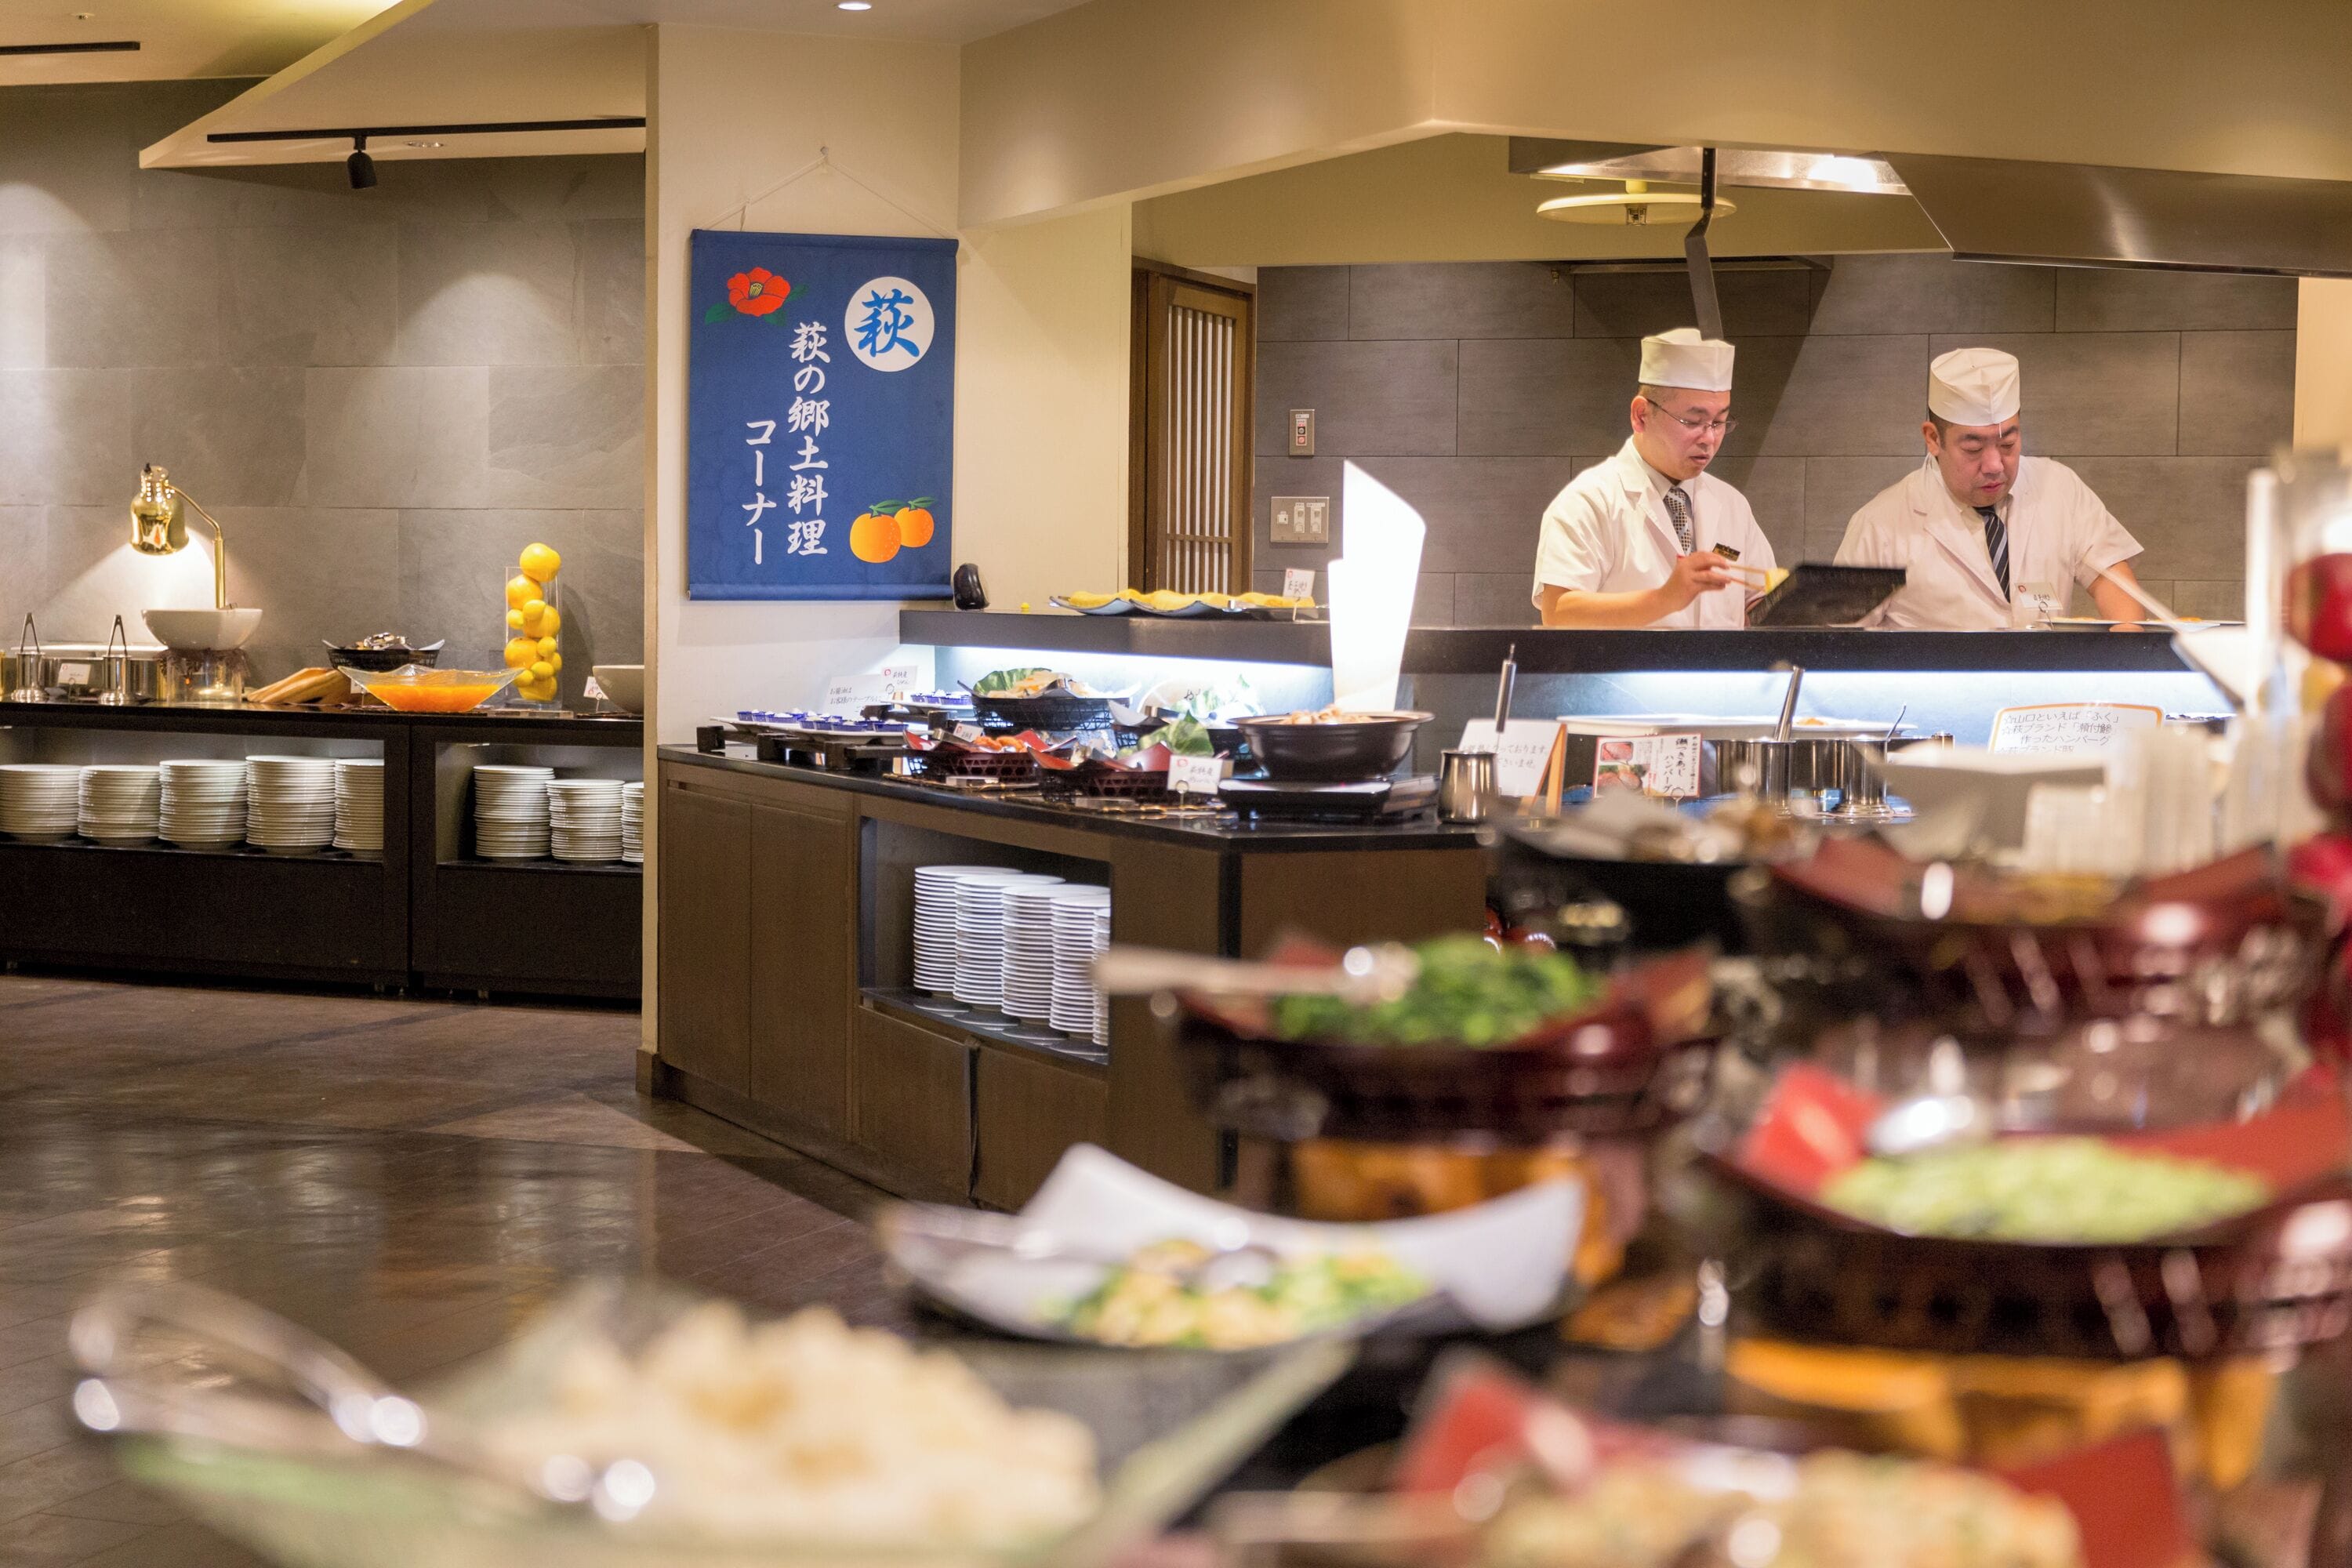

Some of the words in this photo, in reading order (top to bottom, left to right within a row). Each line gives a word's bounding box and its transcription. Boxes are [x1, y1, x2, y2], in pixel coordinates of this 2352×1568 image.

[854, 288, 920, 358] 萩
[742, 419, 777, 565] コーナー
[787, 321, 831, 556] 萩の郷土料理
[1663, 755, 1674, 793] ハンバーグ
